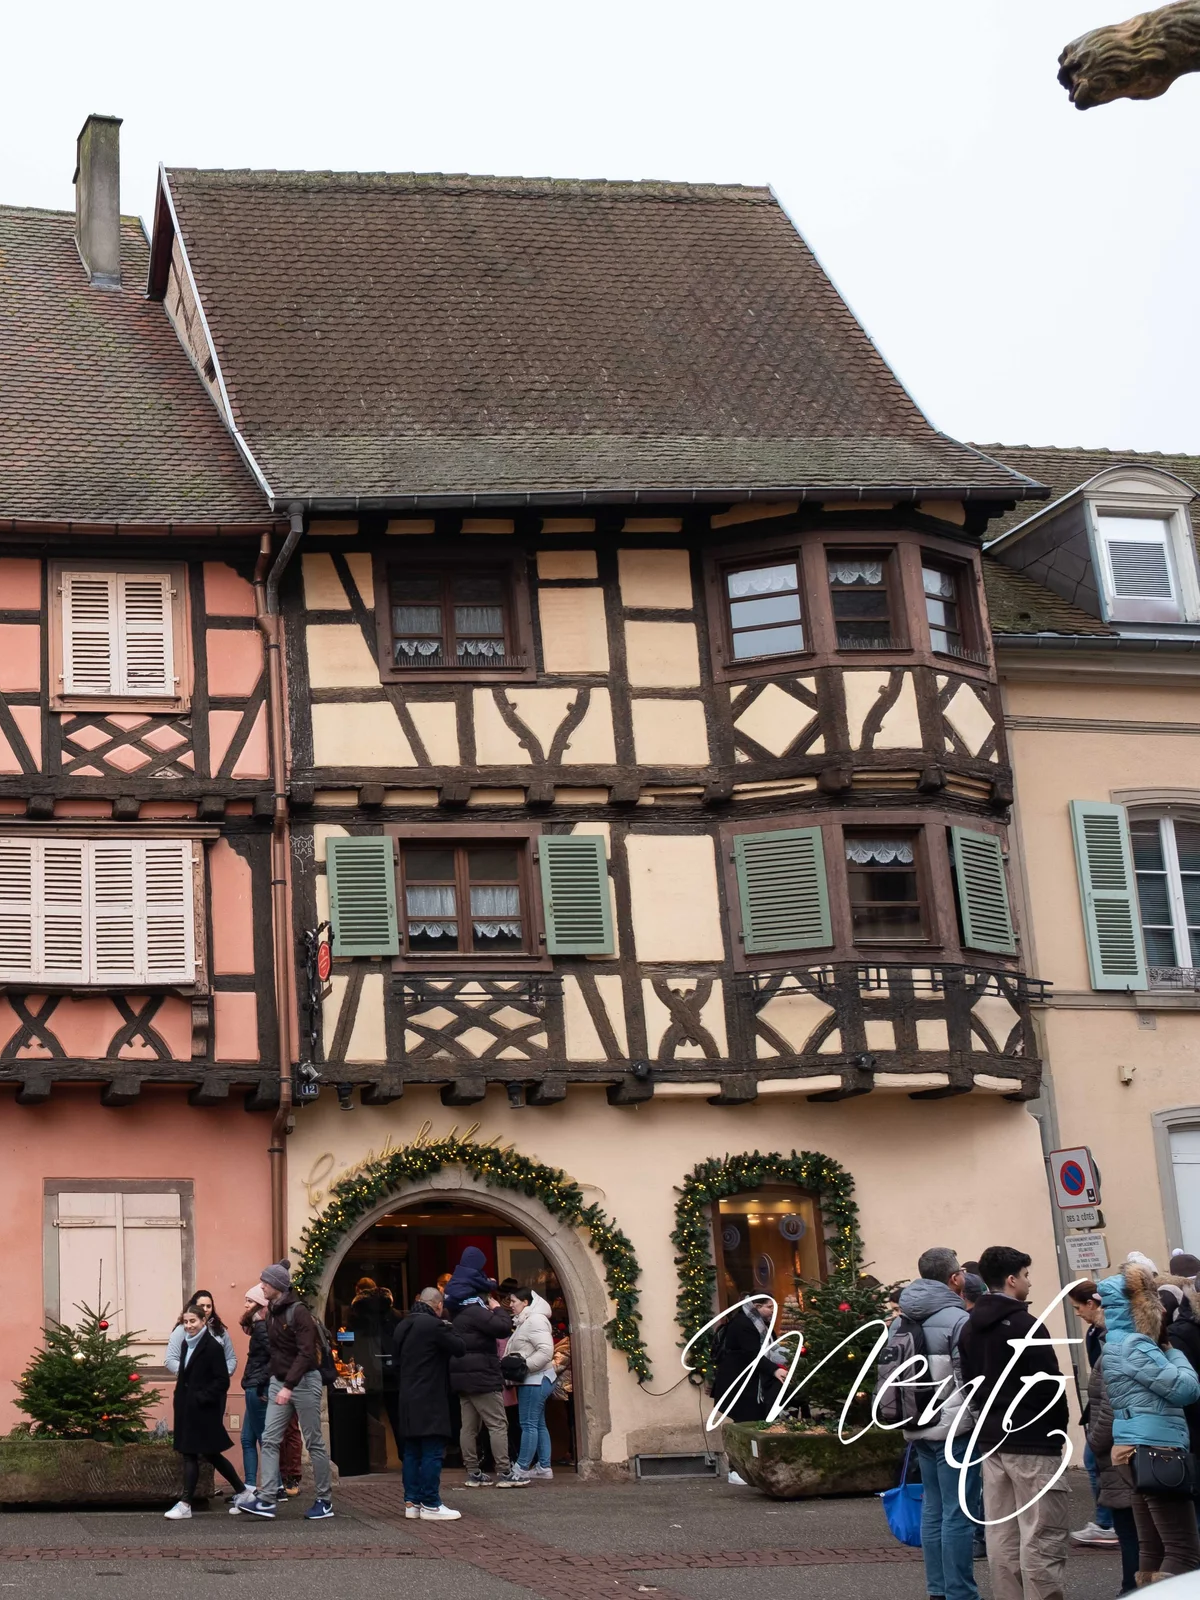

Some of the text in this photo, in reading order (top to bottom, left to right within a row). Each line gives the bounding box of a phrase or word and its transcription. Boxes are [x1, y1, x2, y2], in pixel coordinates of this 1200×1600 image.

[305, 1085, 316, 1094] 12
[378, 1134, 404, 1159] des
[1081, 1213, 1095, 1221] CÔTÉS
